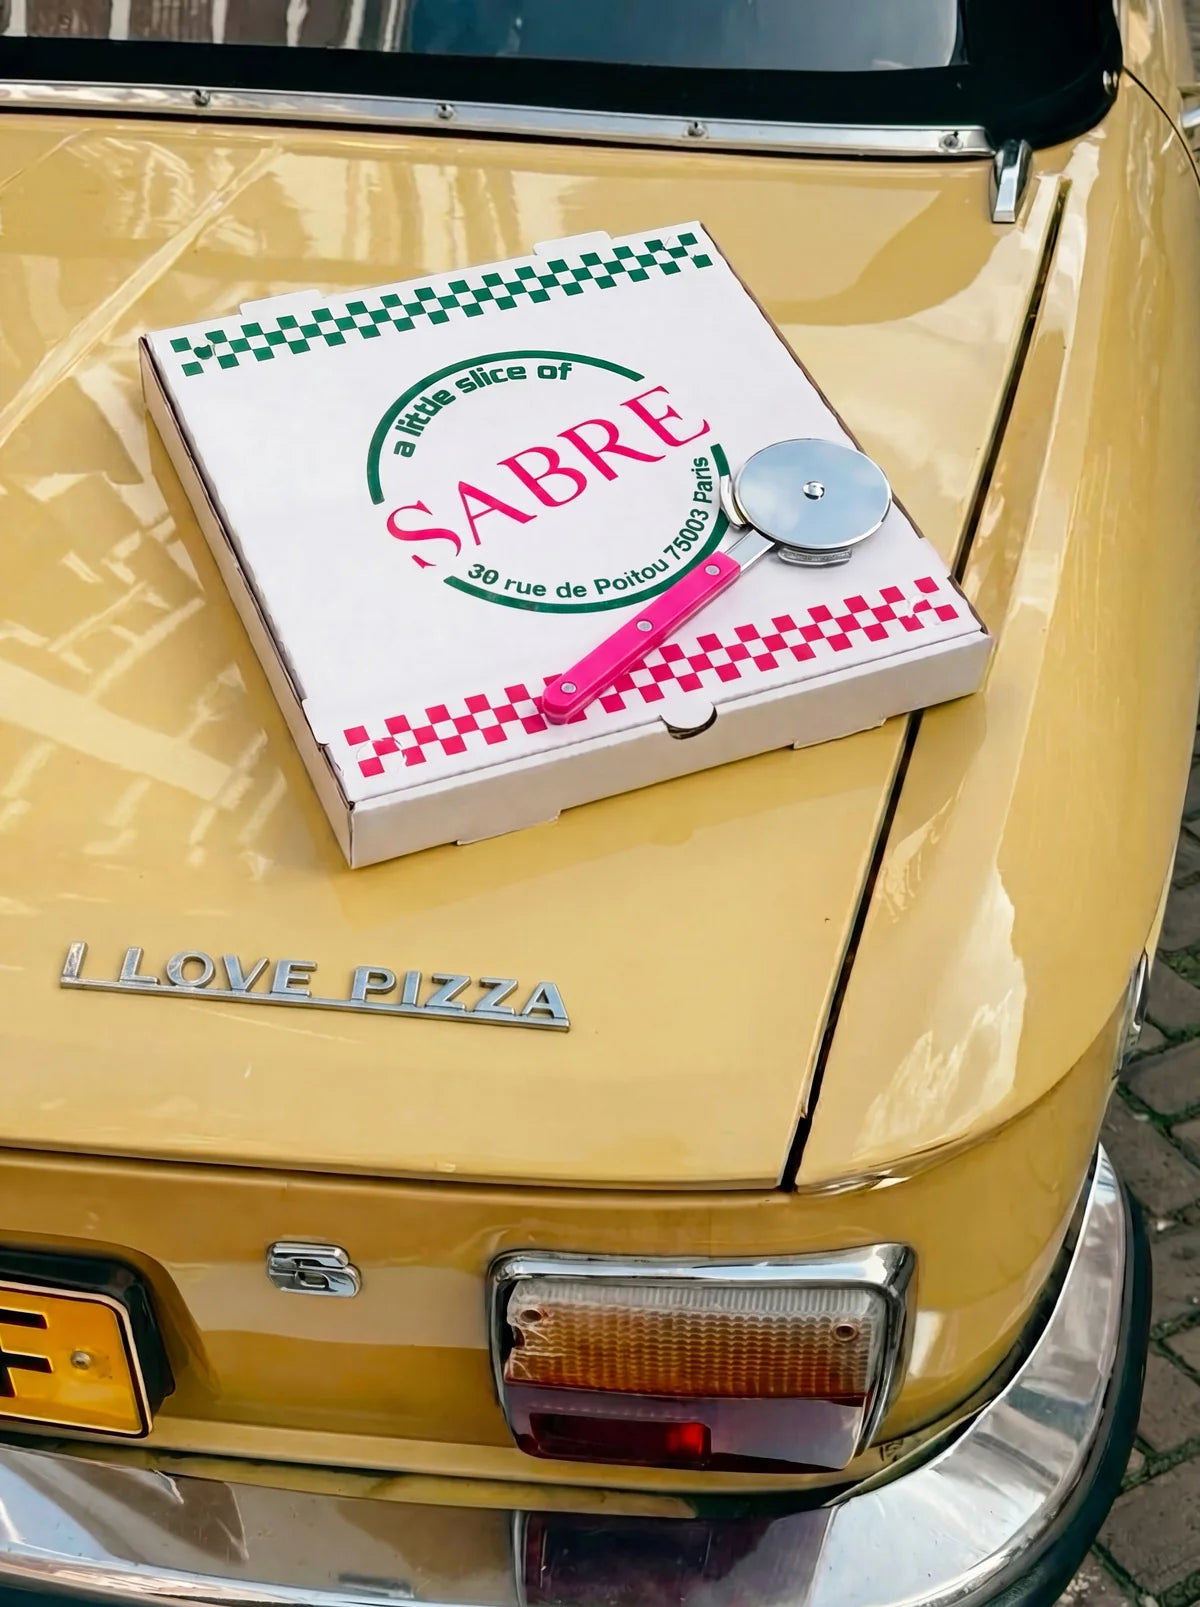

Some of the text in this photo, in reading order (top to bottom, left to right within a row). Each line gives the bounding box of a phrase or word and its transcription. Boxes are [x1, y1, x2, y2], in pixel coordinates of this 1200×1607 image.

[393, 362, 574, 459] a little slice of
[386, 385, 711, 569] SABRE
[467, 456, 713, 598] 30 rue de Poitou 75003 Paris
[62, 941, 569, 1020] I LOVE PIZZA
